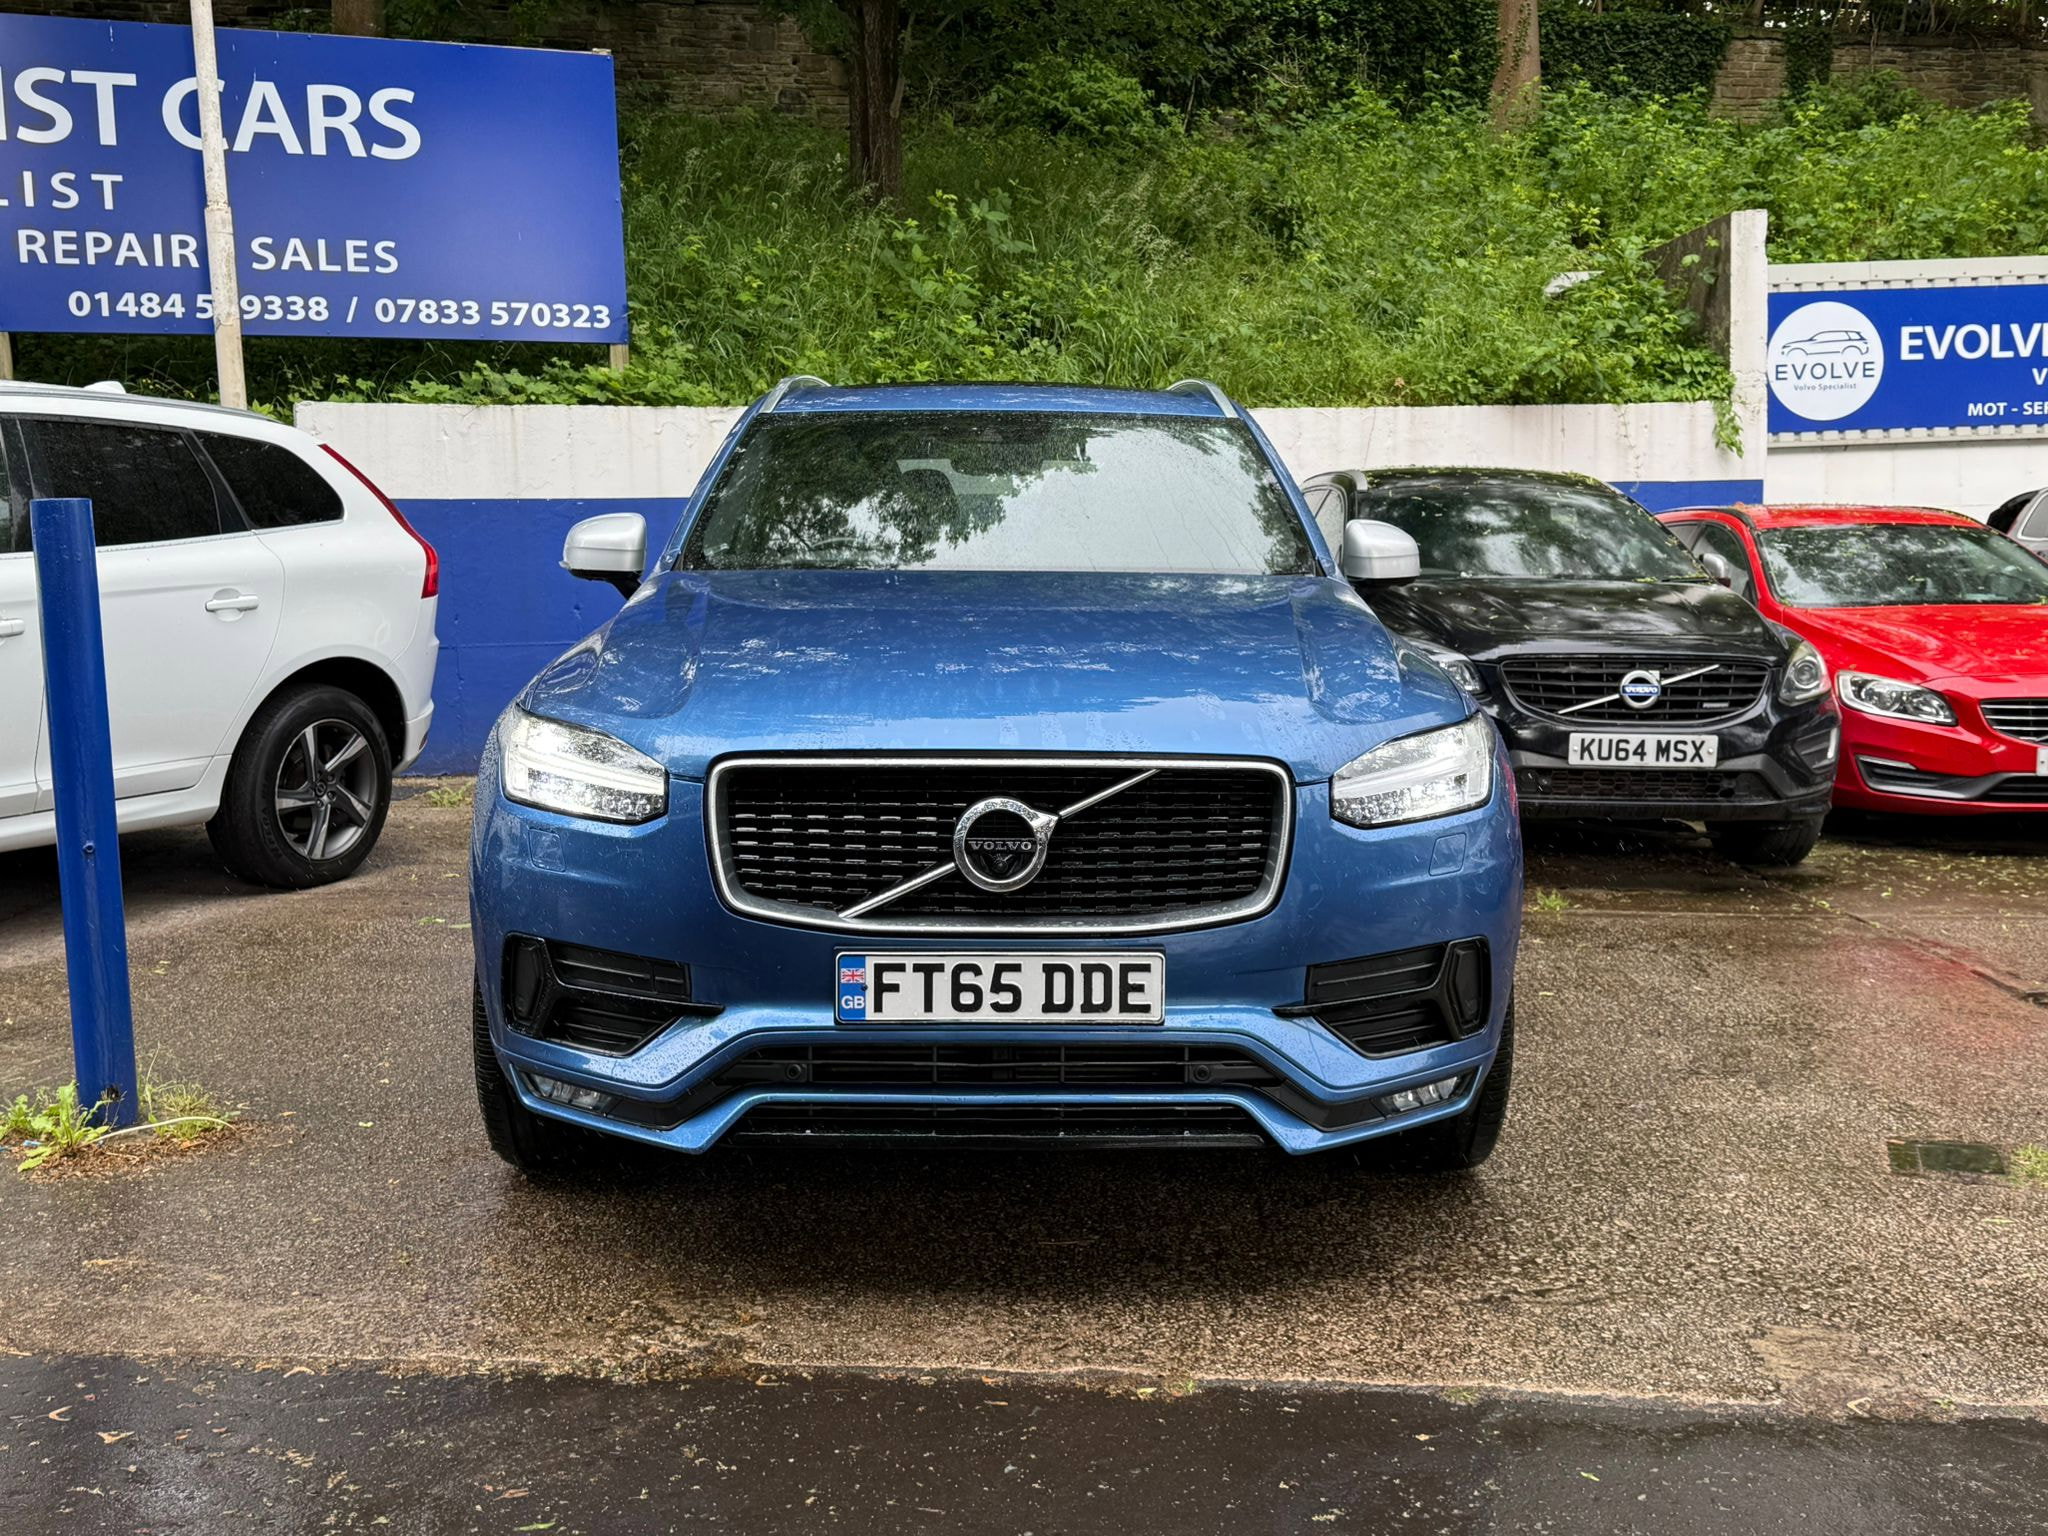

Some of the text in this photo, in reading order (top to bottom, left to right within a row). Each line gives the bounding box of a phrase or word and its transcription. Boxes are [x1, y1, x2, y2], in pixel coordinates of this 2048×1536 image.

[161, 77, 423, 161] CARS
[17, 229, 399, 274] REPAIR SALES
[68, 291, 611, 329] 01484 59338 / 07833 570323
[1775, 361, 1876, 381] EVOLVE
[1793, 381, 1857, 392] Volvo Specialist
[1967, 402, 2008, 417] MOT
[1624, 686, 1658, 694] VOLVO
[1579, 738, 1705, 763] KU64 MSX
[968, 841, 1032, 851] VOLVO
[873, 962, 1152, 1014] FT65 DDE
[841, 995, 865, 1009] GB
